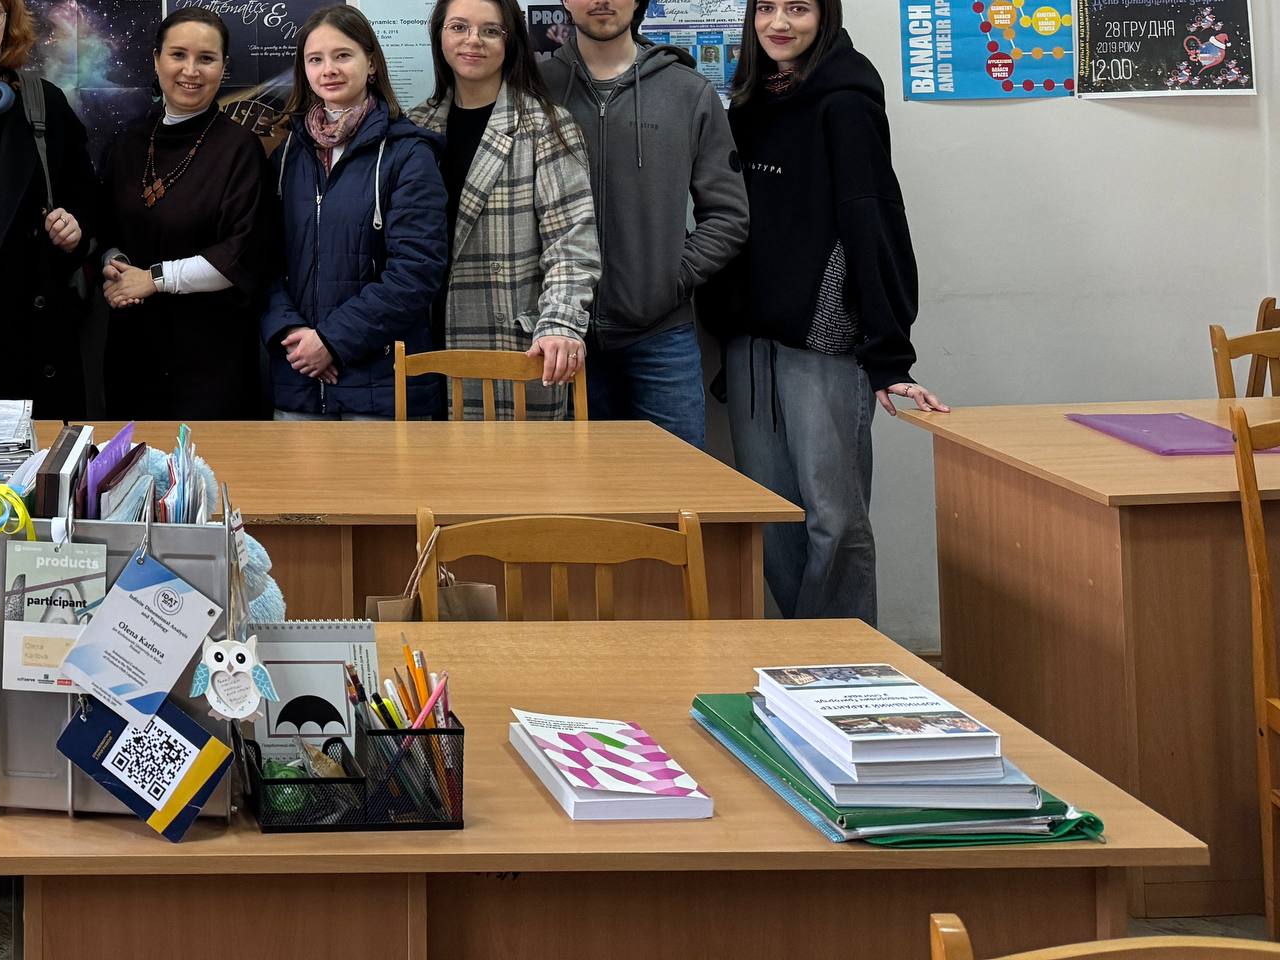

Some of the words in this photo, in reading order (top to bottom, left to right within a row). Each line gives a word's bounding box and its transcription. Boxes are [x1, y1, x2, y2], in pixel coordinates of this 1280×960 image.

[263, 2, 288, 27] &
[531, 10, 567, 25] PRO
[1105, 21, 1121, 38] 28
[1123, 20, 1176, 39] ГРУДНЯ
[936, 19, 953, 60] THEIR
[1097, 41, 1117, 53] 2019
[1118, 41, 1141, 53] РОКУ
[907, 4, 935, 94] BANACH
[937, 63, 954, 93] AND
[751, 162, 782, 174] ЬТУРА
[36, 556, 100, 570] products
[26, 596, 88, 609] participant
[161, 592, 178, 607] IDAT
[171, 624, 188, 640] Analysis
[118, 621, 139, 641] Olena
[138, 636, 165, 660] Karlova
